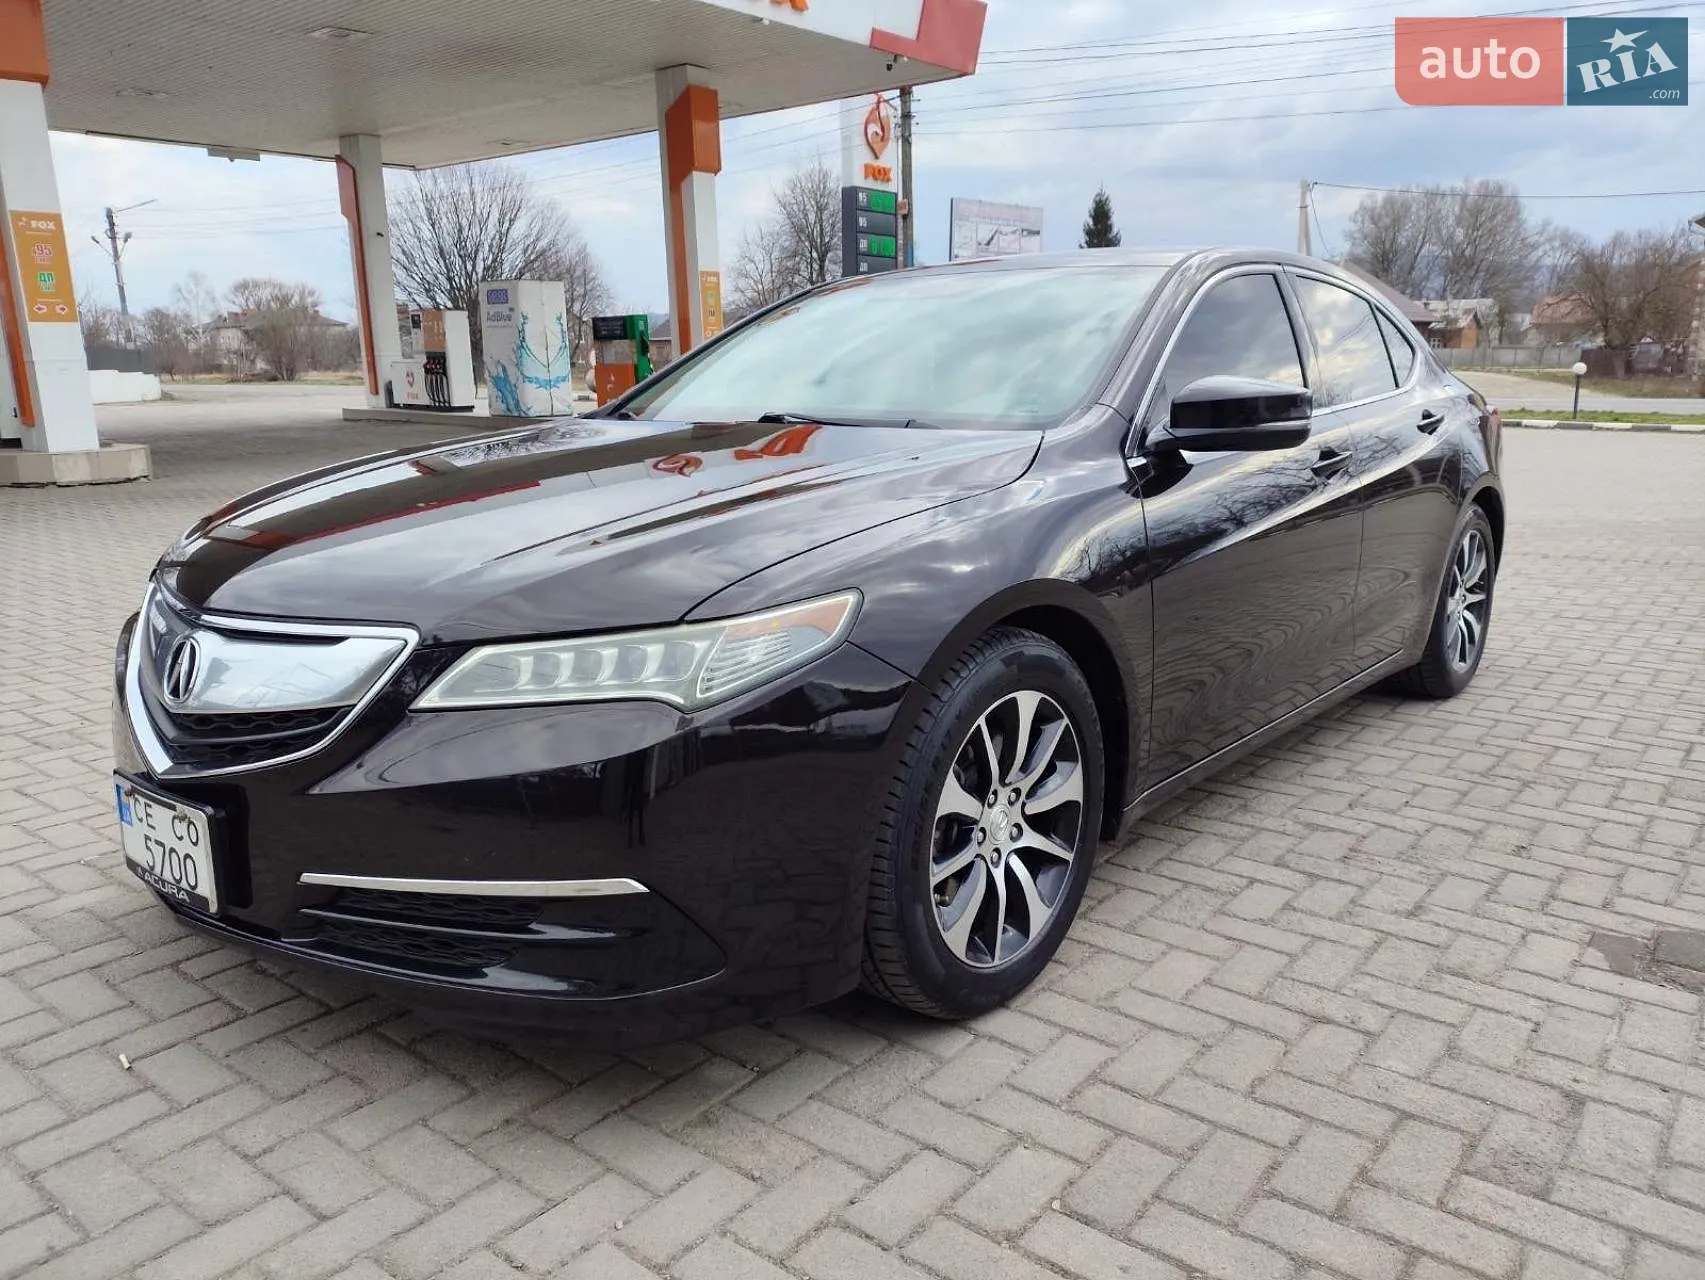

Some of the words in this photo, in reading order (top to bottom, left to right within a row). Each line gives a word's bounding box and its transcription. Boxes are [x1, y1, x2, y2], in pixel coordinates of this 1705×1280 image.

[864, 163, 891, 183] FOX
[30, 220, 56, 230] FOX
[134, 797, 156, 831] CE
[144, 834, 199, 891] 5700
[143, 870, 190, 903] ACURA
